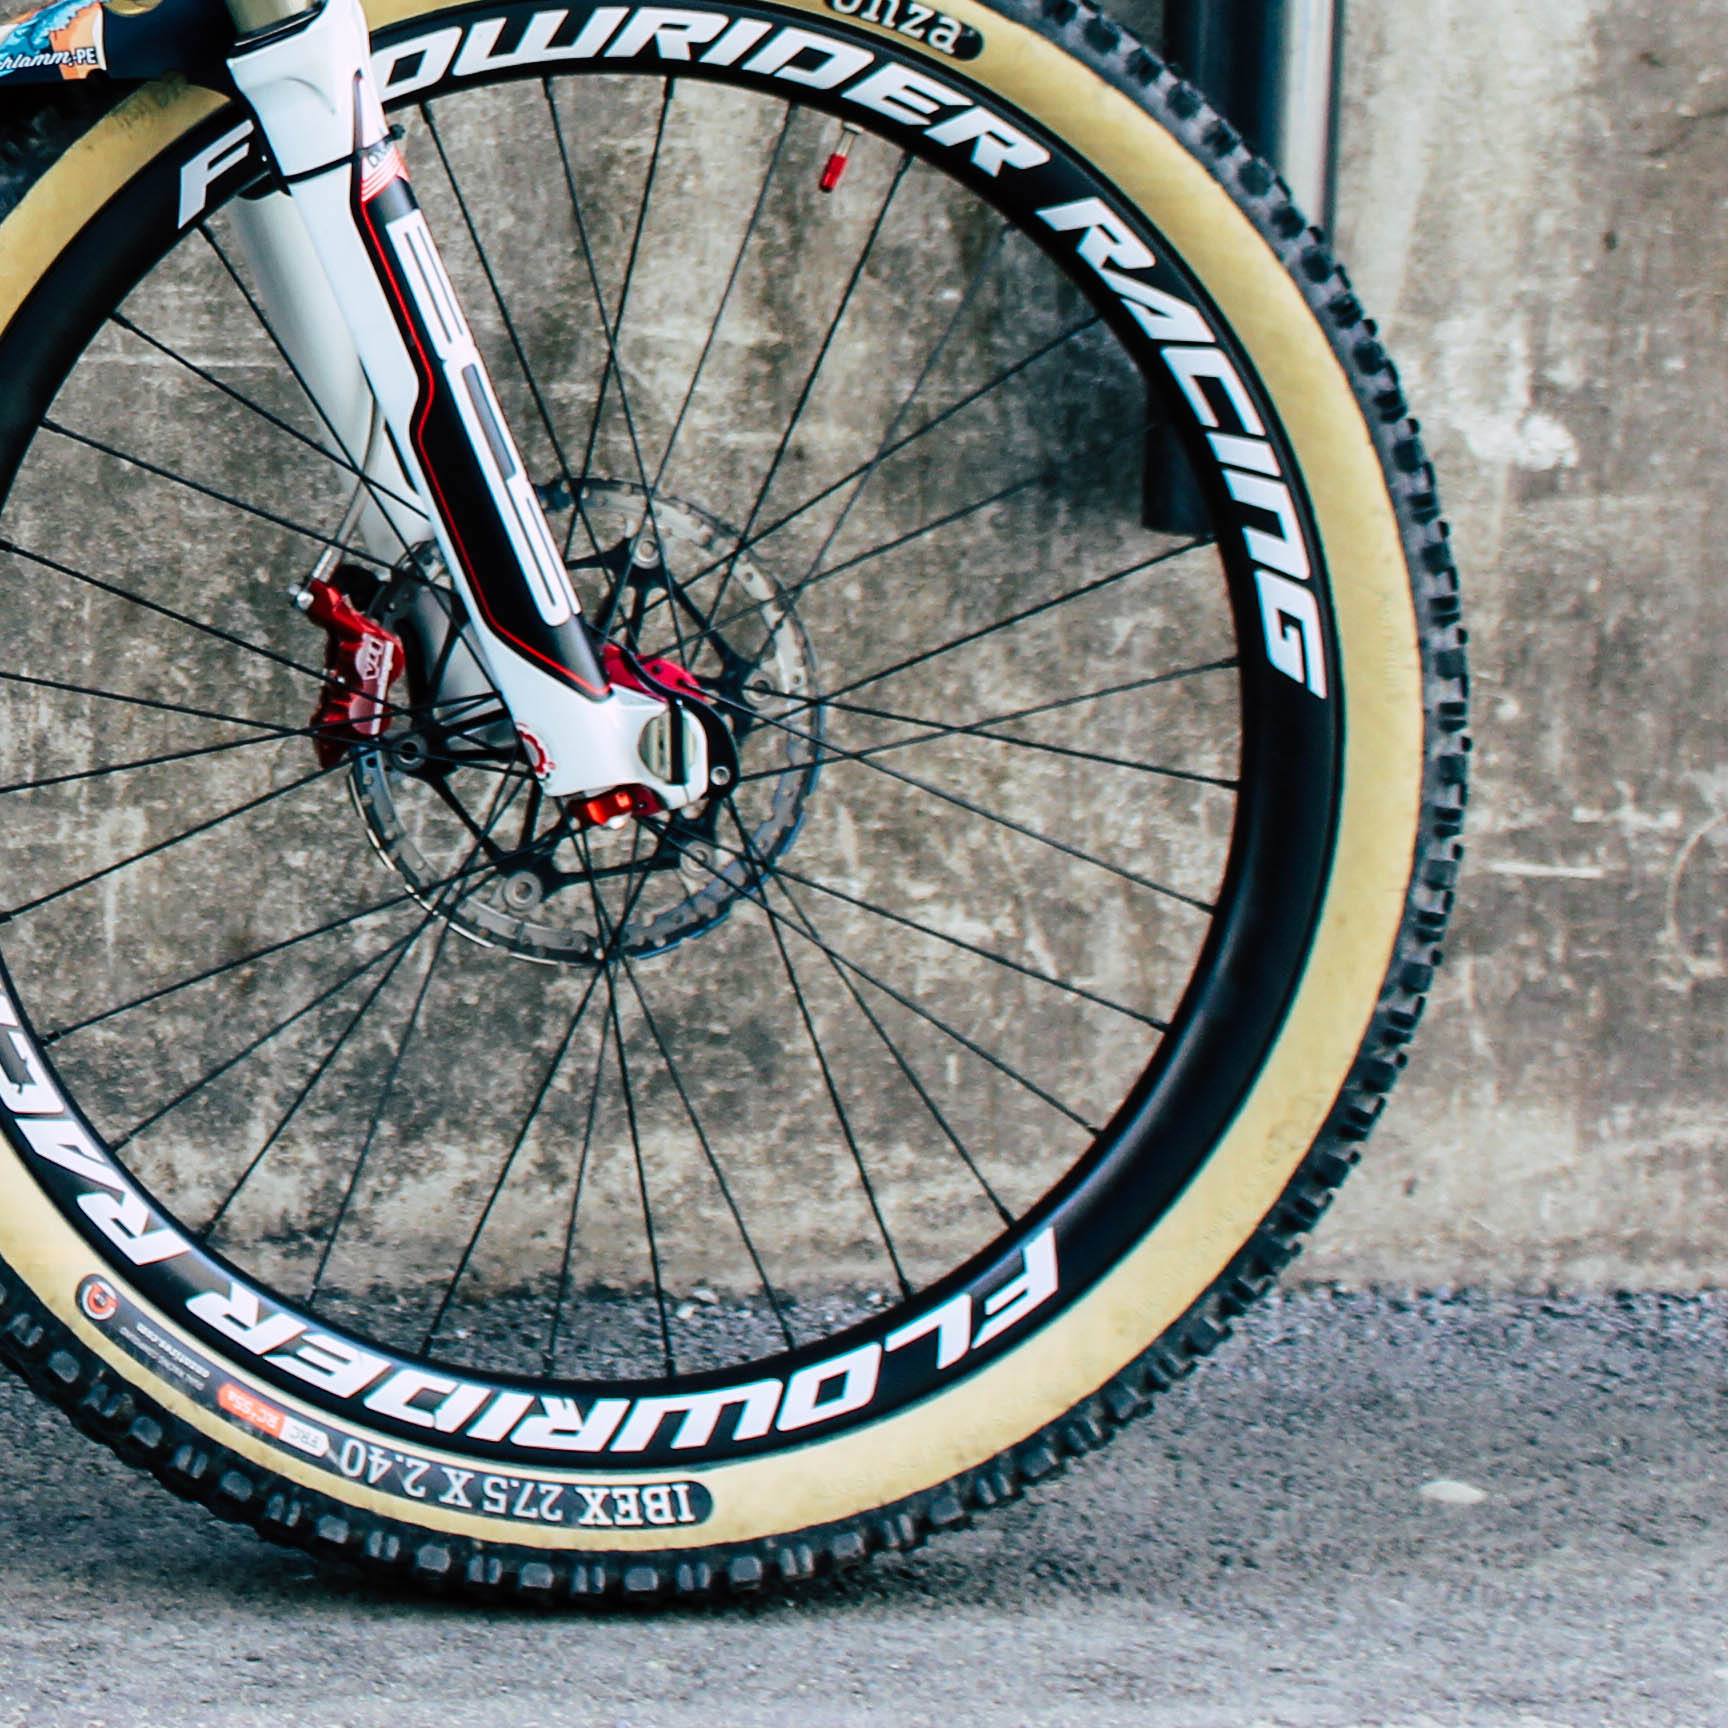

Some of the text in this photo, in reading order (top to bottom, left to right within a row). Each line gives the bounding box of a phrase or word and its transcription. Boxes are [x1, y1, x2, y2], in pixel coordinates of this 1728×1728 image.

[177, 6, 1050, 230] FOWRIDER
[1035, 196, 1328, 700] RACING
[185, 1226, 1060, 1453] FLOWRIDER
[338, 1438, 695, 1527] IBEX 27.5 X 2.40
